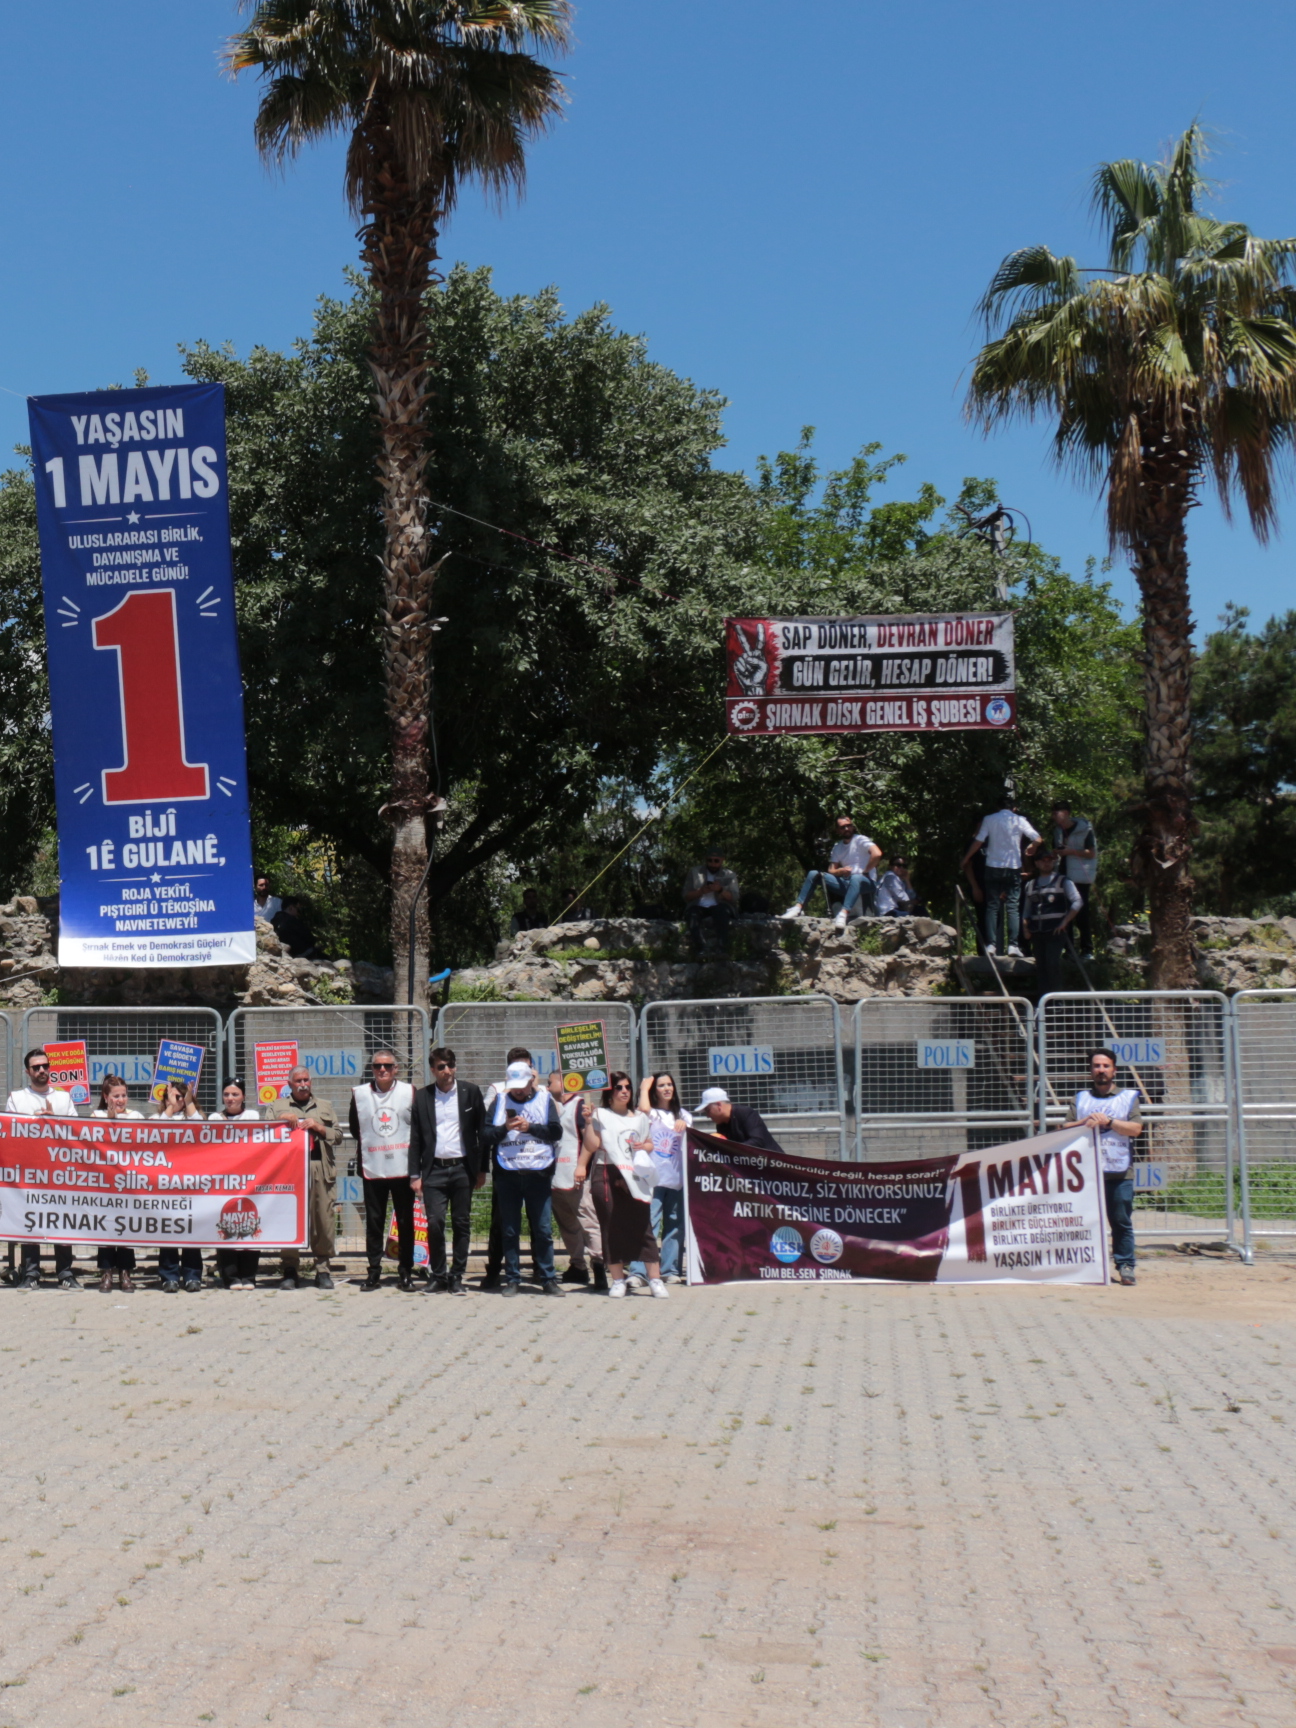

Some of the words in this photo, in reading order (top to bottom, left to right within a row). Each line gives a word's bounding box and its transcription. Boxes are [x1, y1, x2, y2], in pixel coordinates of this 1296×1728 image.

[70, 408, 184, 448] YAŞASIN
[45, 457, 66, 508] 1
[78, 445, 220, 506] MAYIS
[68, 530, 158, 549] ULUSLARARASI
[161, 524, 203, 544] BİRLİK,
[92, 549, 161, 567] DAYANIŞMA
[164, 547, 179, 561] VE
[86, 568, 149, 586] MÜCADELE
[152, 564, 189, 581] GÜNÜ!
[782, 626, 812, 650] SAP
[817, 620, 872, 651] DÖNER,
[876, 623, 938, 648] DEVRAN
[944, 616, 994, 647] DÖNER
[792, 657, 824, 687] GÜN
[829, 656, 876, 688] GELİR,
[881, 658, 931, 684] HESAP
[935, 654, 993, 683] DÖNER!
[91, 587, 211, 806] 1
[766, 703, 822, 730] ŞIRNAK
[826, 694, 861, 725] DİSK
[866, 700, 909, 725] GENEL
[913, 698, 927, 727] İŞ
[931, 696, 981, 727] ŞUBESİ
[129, 808, 177, 838] BİJÎ
[86, 839, 115, 870] 1Ê
[122, 834, 226, 869] GULANÊ,
[122, 887, 151, 900] ROJA
[154, 883, 193, 899] YEKÎTÎ,
[100, 901, 148, 918] PIŞTGIRÎ
[150, 900, 158, 914] Û
[161, 899, 215, 916] TÊKOŞÎNA
[115, 915, 198, 931] NAVNETEWEYÎ!
[112, 942, 134, 951] Emek
[149, 940, 194, 950] Demokrasi
[196, 938, 227, 950] Güçleri
[131, 952, 147, 961] Ked
[157, 952, 211, 963] Demokrasiyê
[563, 1042, 590, 1051] SAVAŞA
[924, 1040, 969, 1067] POLİS
[1111, 1039, 1160, 1062] POLİS
[92, 1057, 152, 1081] POLİS
[305, 1050, 356, 1075] POLİS
[569, 1056, 598, 1069] SON!
[712, 1047, 772, 1074] POLİS
[49, 1069, 83, 1083] SON!
[11, 1118, 104, 1142] İNSANLAR
[109, 1127, 132, 1143] VE
[136, 1128, 195, 1144] HATTA
[199, 1124, 248, 1144] ÖLÜM
[252, 1124, 292, 1143] BİLE
[47, 1147, 172, 1169] YORULDUYSA,
[693, 1149, 731, 1165] “Kadın
[733, 1155, 768, 1171] emeği
[867, 1171, 904, 1182] hesap
[24, 1168, 49, 1184] EN
[52, 1166, 110, 1188] GÜZEL
[114, 1170, 153, 1192] ŞİİR,
[157, 1174, 256, 1193] BARIŞTIR!”
[694, 1173, 722, 1192] “BİZ
[725, 1174, 813, 1200] ÜRETİYORUZ,
[816, 1182, 837, 1199] SİZ
[839, 1183, 944, 1199] YIKIYORSUNUZ
[26, 1190, 66, 1205] İNSAN
[71, 1195, 129, 1209] HAKLARI
[133, 1196, 192, 1210] DERNEĞİ
[237, 1199, 242, 1211] 1
[950, 1160, 987, 1263] 1
[986, 1150, 1085, 1199] MAYIS
[991, 1204, 1025, 1218] BİRLİKTE
[1027, 1202, 1073, 1215] ÜRETİYORUZ
[24, 1211, 107, 1232] ŞIRNAK
[114, 1215, 193, 1236] ŞUBESİ
[223, 1211, 256, 1222] MAYIS
[733, 1201, 774, 1219] ARTIK
[776, 1203, 831, 1222] TERSİNE
[834, 1205, 907, 1224] DÖNECEK”
[992, 1218, 1026, 1231] BİRLİKTE
[1028, 1215, 1084, 1232] GÜÇLENİYORUZ
[770, 1241, 806, 1253] KESK
[993, 1233, 1028, 1246] BİRLİKTE
[994, 1250, 1042, 1270] YAŞASIN
[1047, 1251, 1051, 1265] 1
[1055, 1246, 1095, 1265] MAYIS!
[759, 1266, 780, 1279] TÜM
[781, 1268, 816, 1279] BEL-SEN
[819, 1268, 852, 1281] ŞIRNAK
